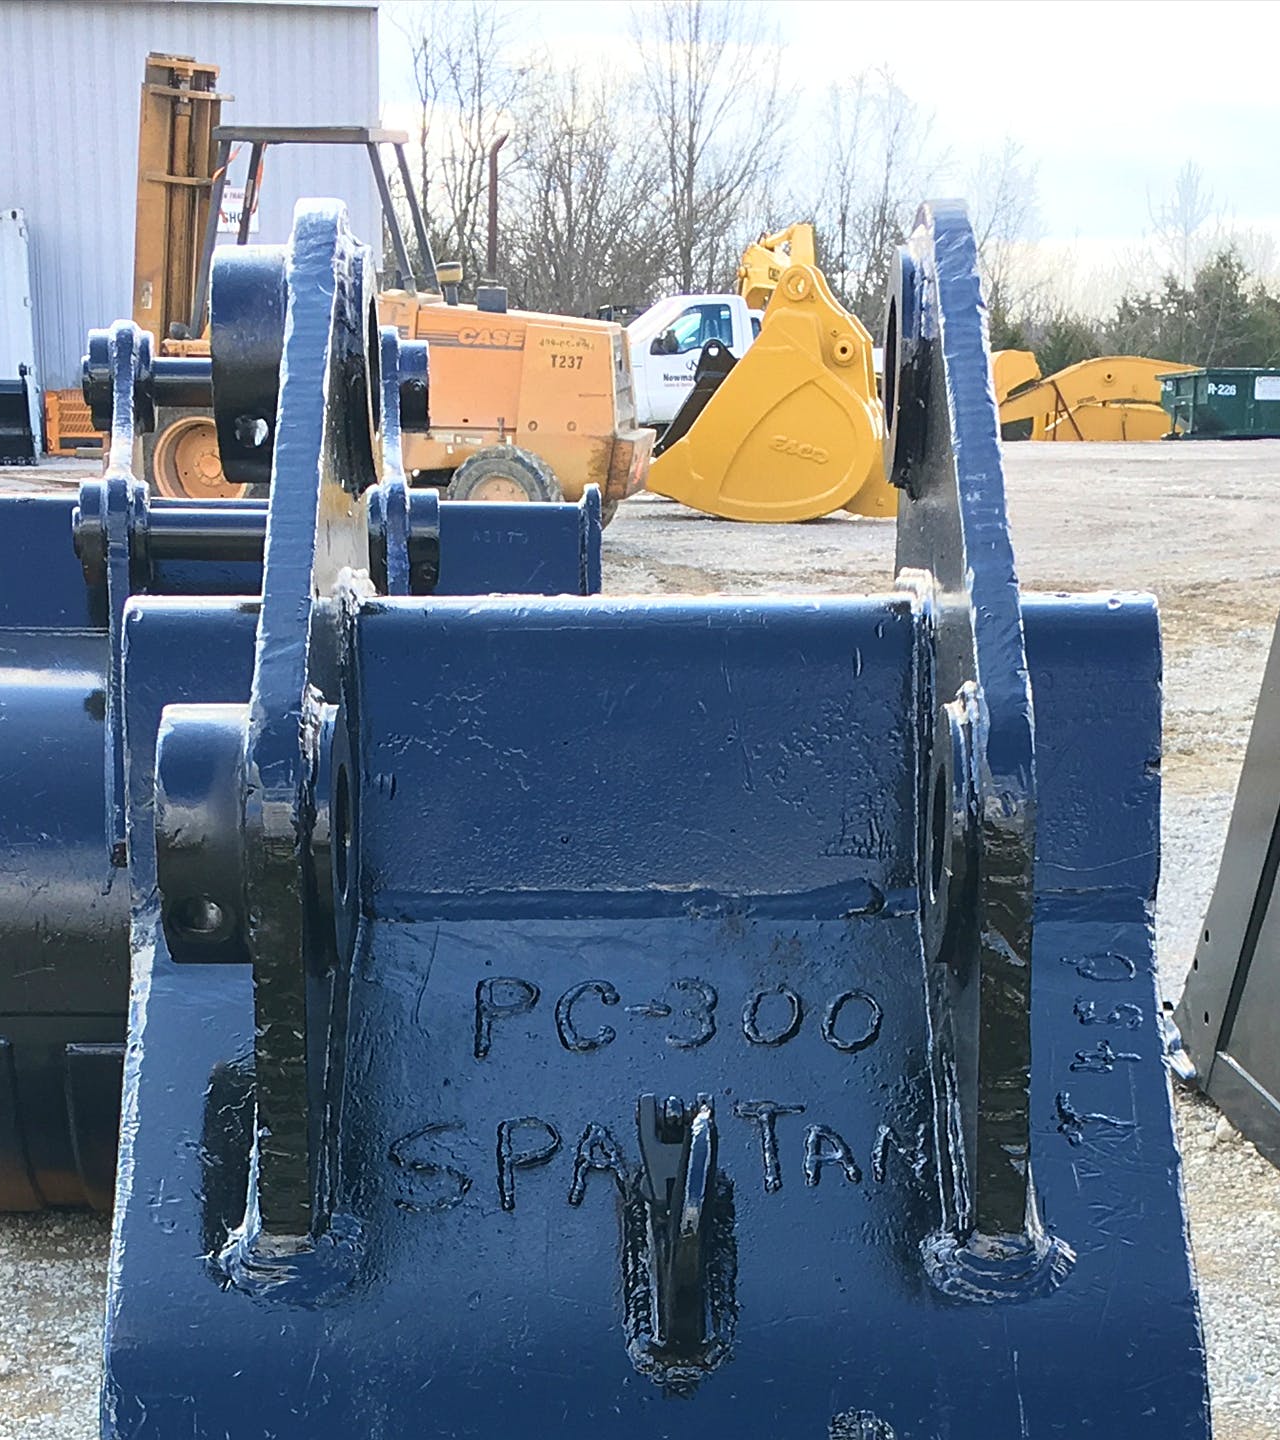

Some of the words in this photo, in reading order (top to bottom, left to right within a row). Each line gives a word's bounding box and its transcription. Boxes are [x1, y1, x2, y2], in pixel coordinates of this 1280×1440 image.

[457, 327, 524, 347] CASE
[551, 354, 583, 370] T237
[663, 373, 694, 382] Newma
[1207, 382, 1237, 396] R-226
[474, 976, 884, 1059] PC-300
[388, 1100, 926, 1213] SPATAN
